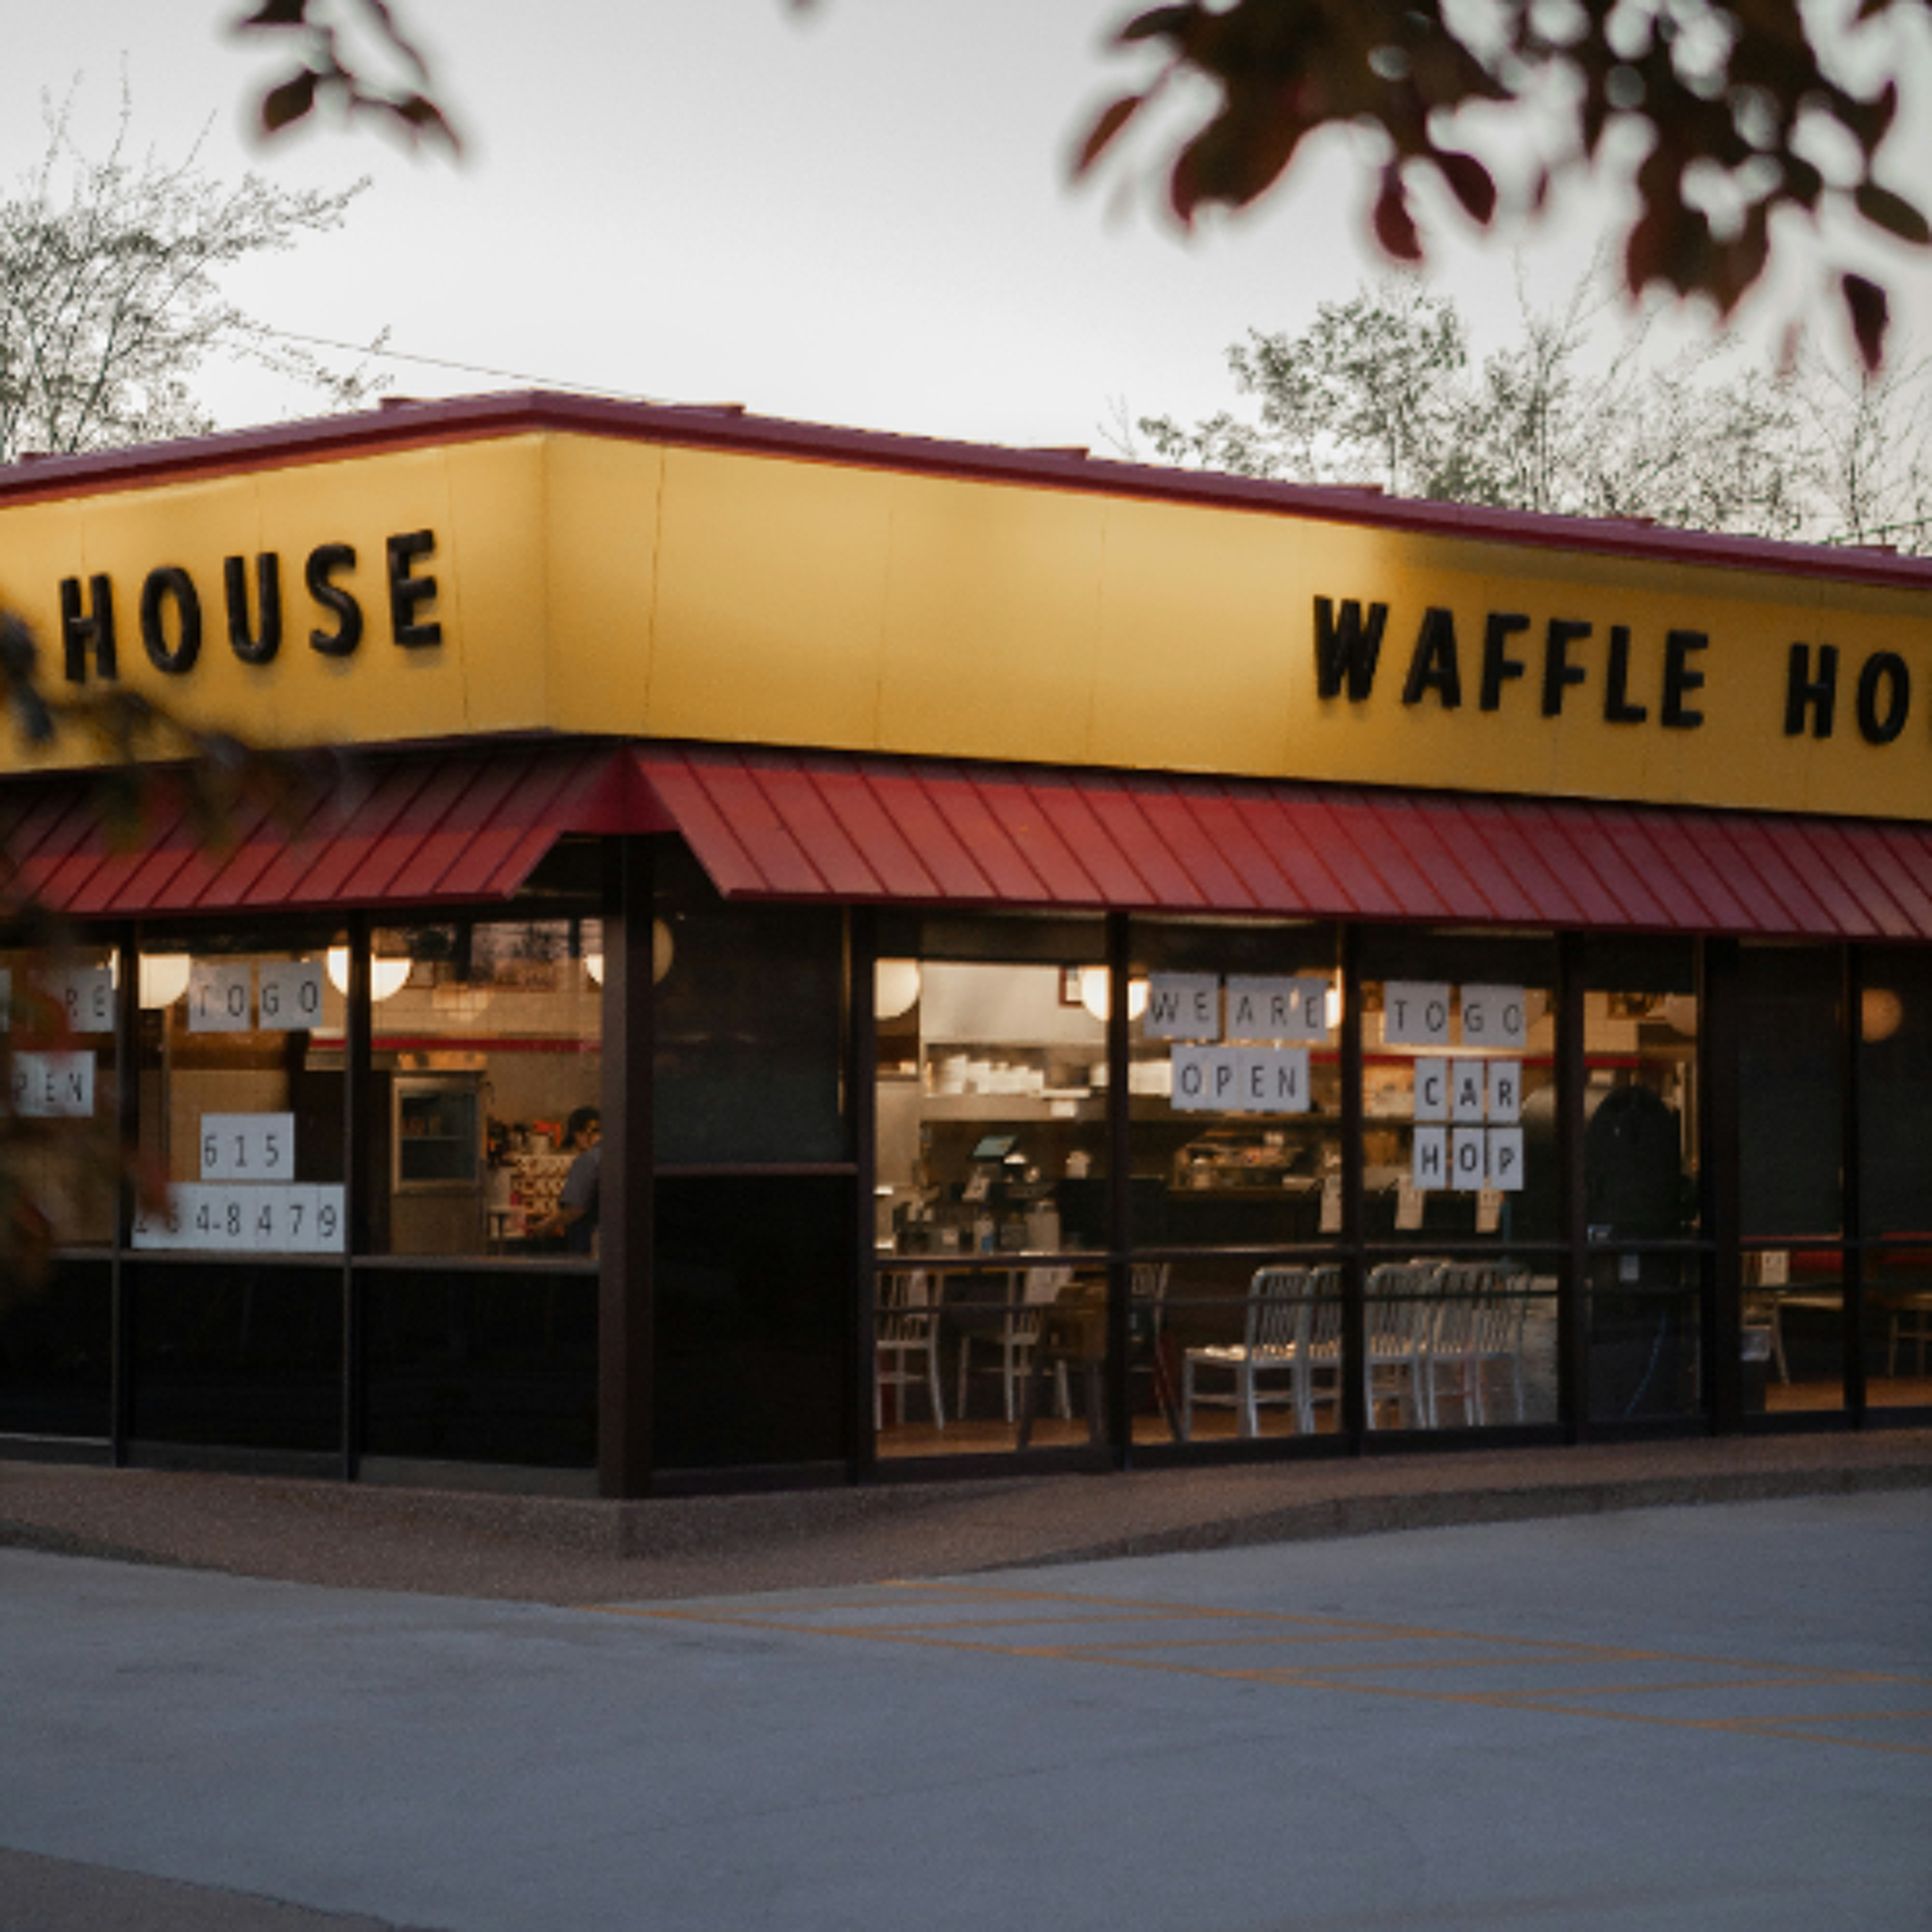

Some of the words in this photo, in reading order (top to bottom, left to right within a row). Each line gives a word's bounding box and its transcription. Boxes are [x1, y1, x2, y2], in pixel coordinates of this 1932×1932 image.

[59, 529, 442, 683] HOUSE
[1313, 594, 1709, 728] WAFFLE
[1784, 641, 1932, 746] HO
[66, 985, 105, 1017] RE
[1151, 992, 1209, 1024] WE
[1236, 996, 1318, 1028] ARE
[14, 1072, 82, 1102] PEN
[1181, 1064, 1296, 1097] OPEN
[1425, 1075, 1512, 1108] CAR
[204, 1135, 279, 1168] 615
[1421, 1143, 1515, 1176] HOP
